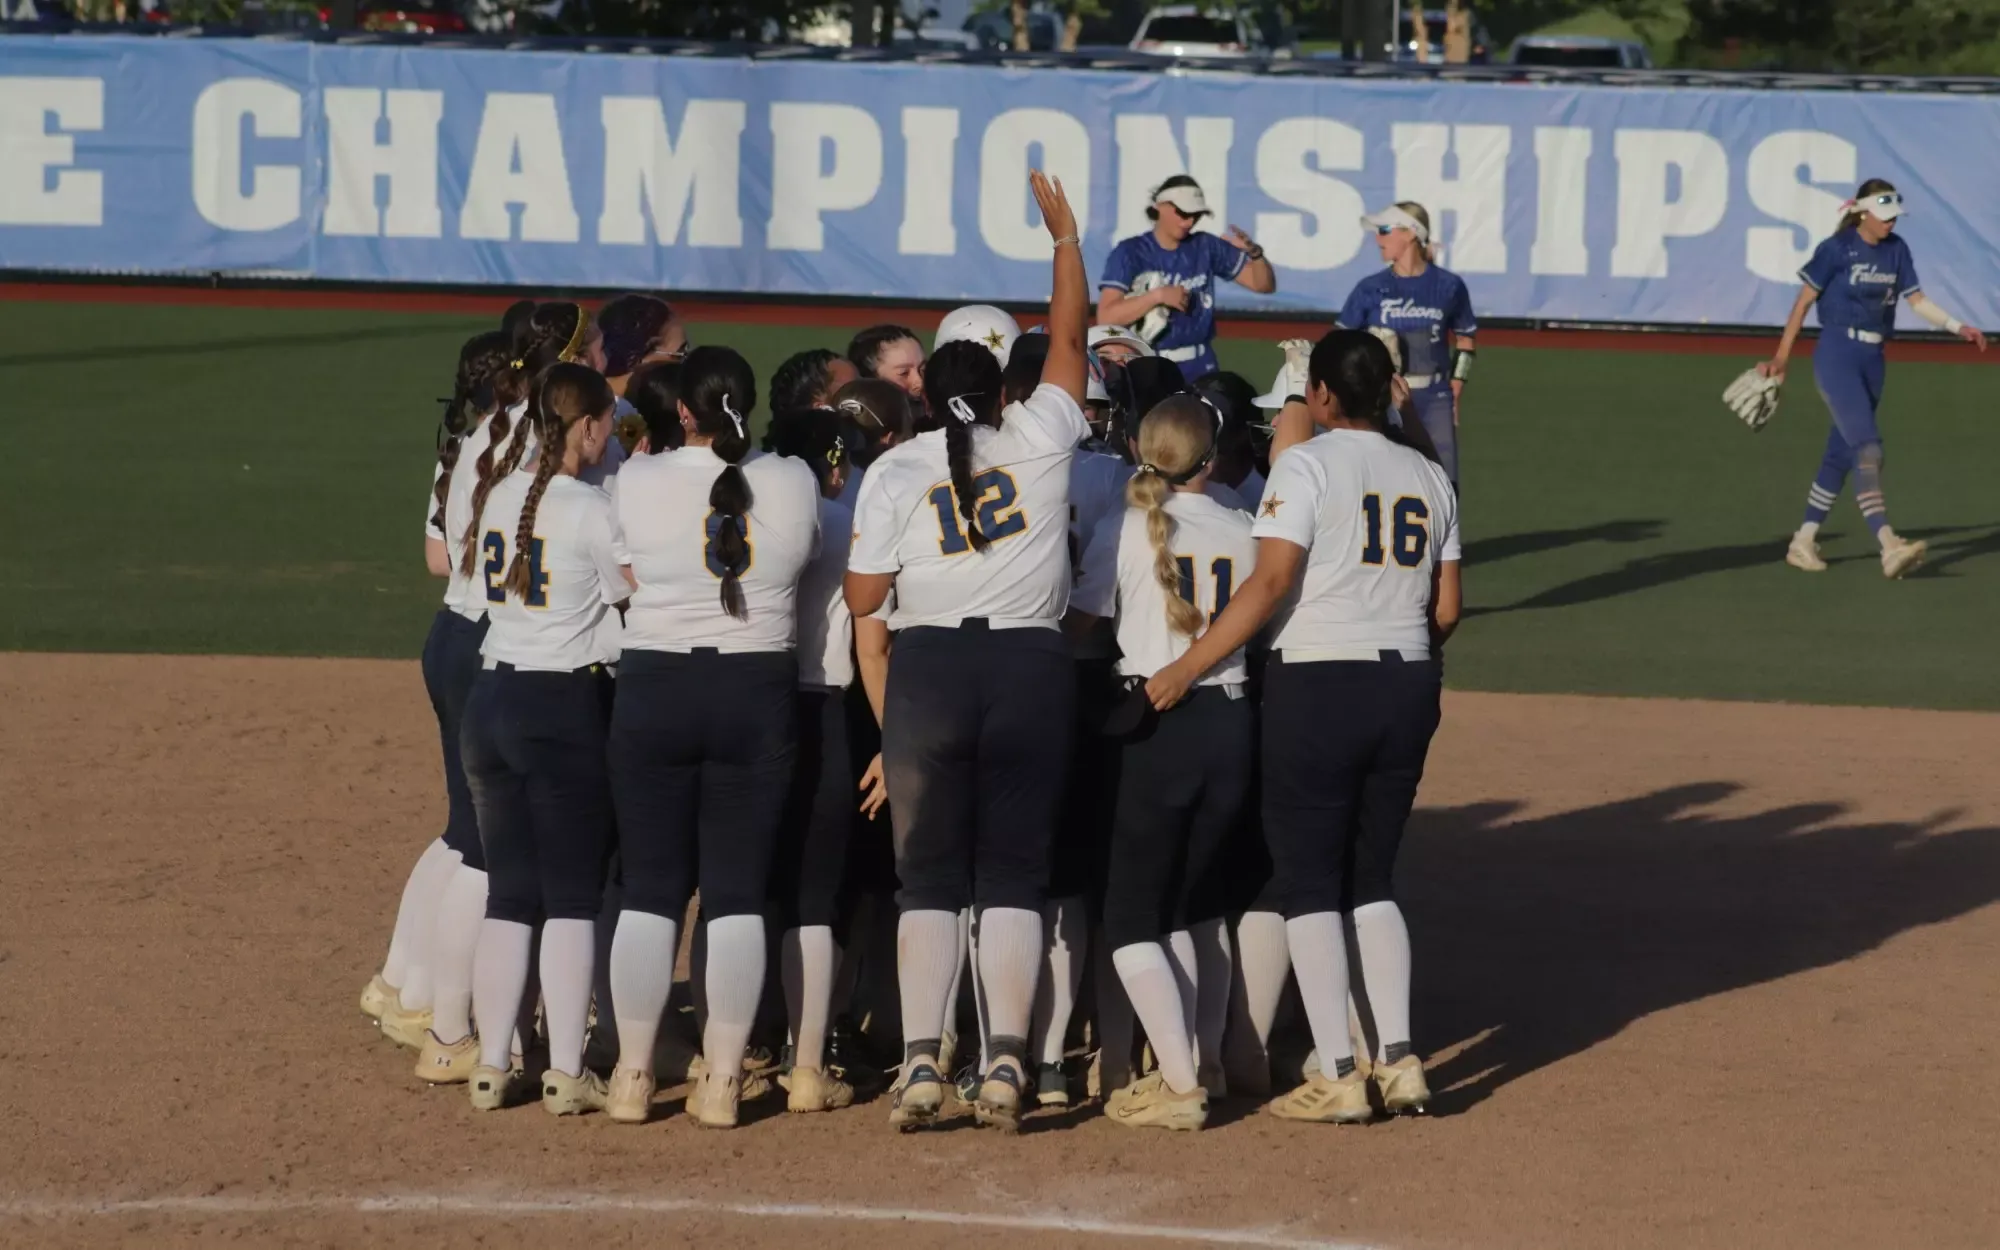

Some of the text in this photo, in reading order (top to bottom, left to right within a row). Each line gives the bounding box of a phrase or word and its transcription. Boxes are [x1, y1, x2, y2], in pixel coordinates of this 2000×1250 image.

[192, 76, 1858, 285] CHAMPIONSHIPS
[1380, 298, 1443, 324] Falcons
[928, 466, 1029, 557] 12
[1360, 491, 1433, 569] 16
